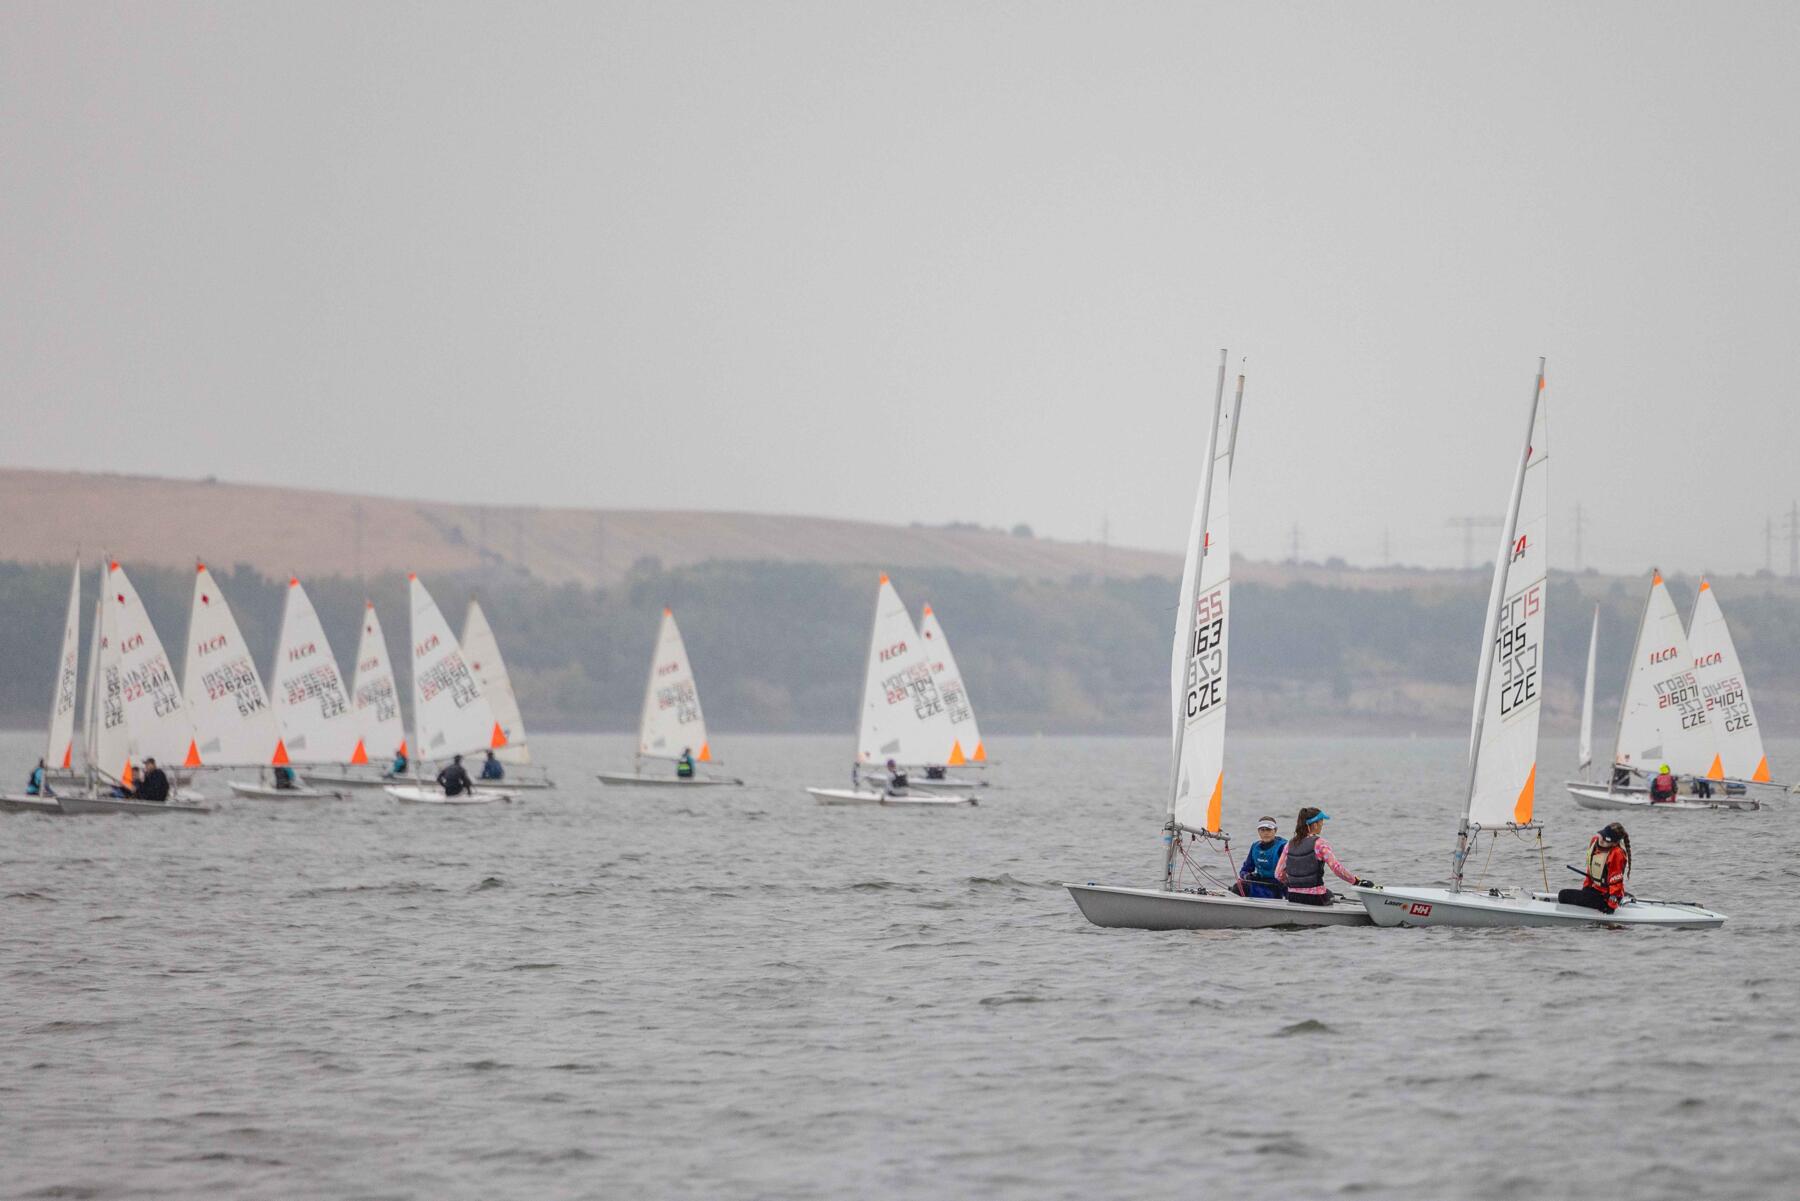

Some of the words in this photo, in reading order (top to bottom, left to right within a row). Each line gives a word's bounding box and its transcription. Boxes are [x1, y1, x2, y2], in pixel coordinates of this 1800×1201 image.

[198, 634, 227, 656] ILCA
[289, 643, 316, 662] ILCA
[416, 634, 440, 657] ILCA
[880, 641, 907, 662] ILCA
[1650, 647, 1677, 665] ILCA
[1694, 652, 1722, 668] ILCA
[453, 688, 480, 709] CZE
[1187, 677, 1222, 718] CZE
[1501, 671, 1537, 716] CZE
[1658, 684, 1700, 709] 216071
[1705, 689, 1744, 711] 24104
[154, 697, 181, 717] CZE
[239, 699, 266, 717] SVK
[322, 703, 347, 720] CZE
[916, 701, 944, 720] CZE
[1681, 710, 1705, 730] CZE
[1725, 714, 1753, 732] CZE
[1411, 904, 1430, 915] HH
